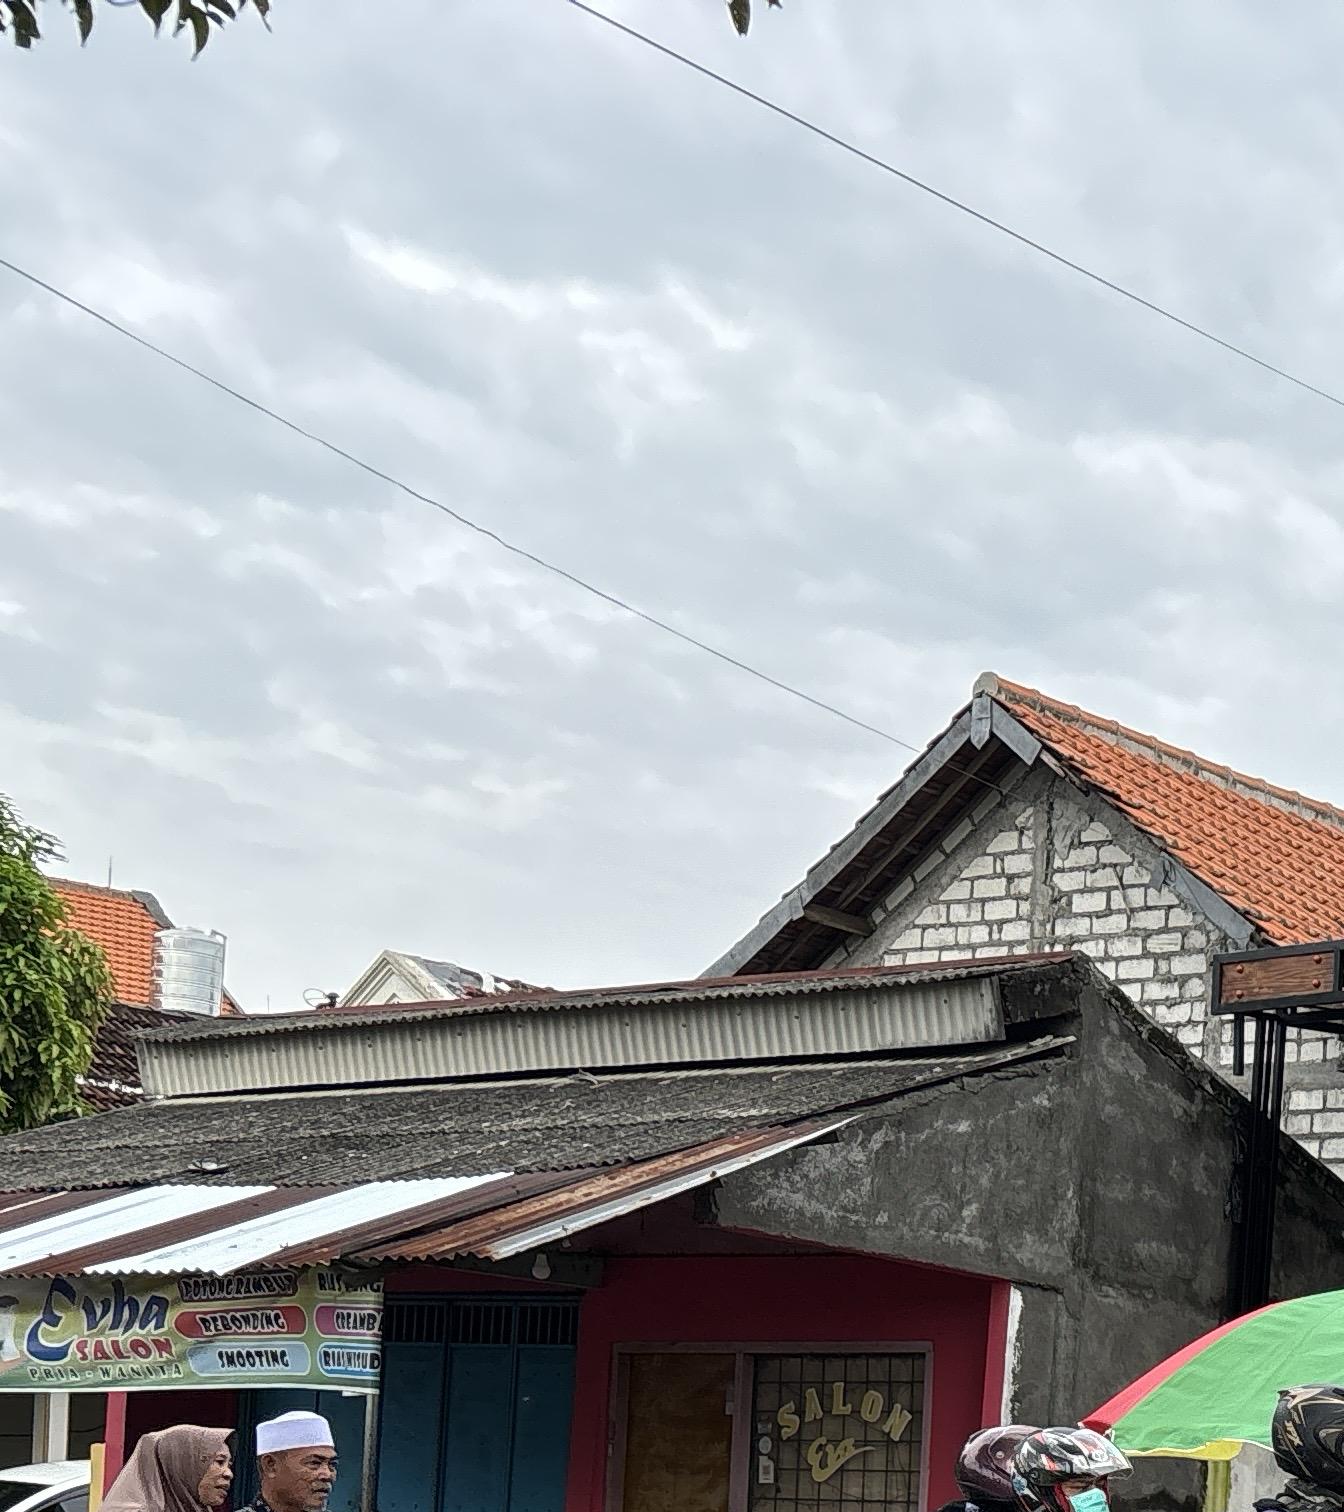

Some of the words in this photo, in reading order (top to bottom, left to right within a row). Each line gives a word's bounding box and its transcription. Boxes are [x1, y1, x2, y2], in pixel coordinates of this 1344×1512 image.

[198, 1310, 289, 1335] REBONDING
[75, 1336, 176, 1362] SALON
[216, 1349, 290, 1369] SMOOTING
[29, 1366, 81, 1381] PRIA
[99, 1364, 184, 1381] WANITA
[777, 1382, 913, 1442] SALON
